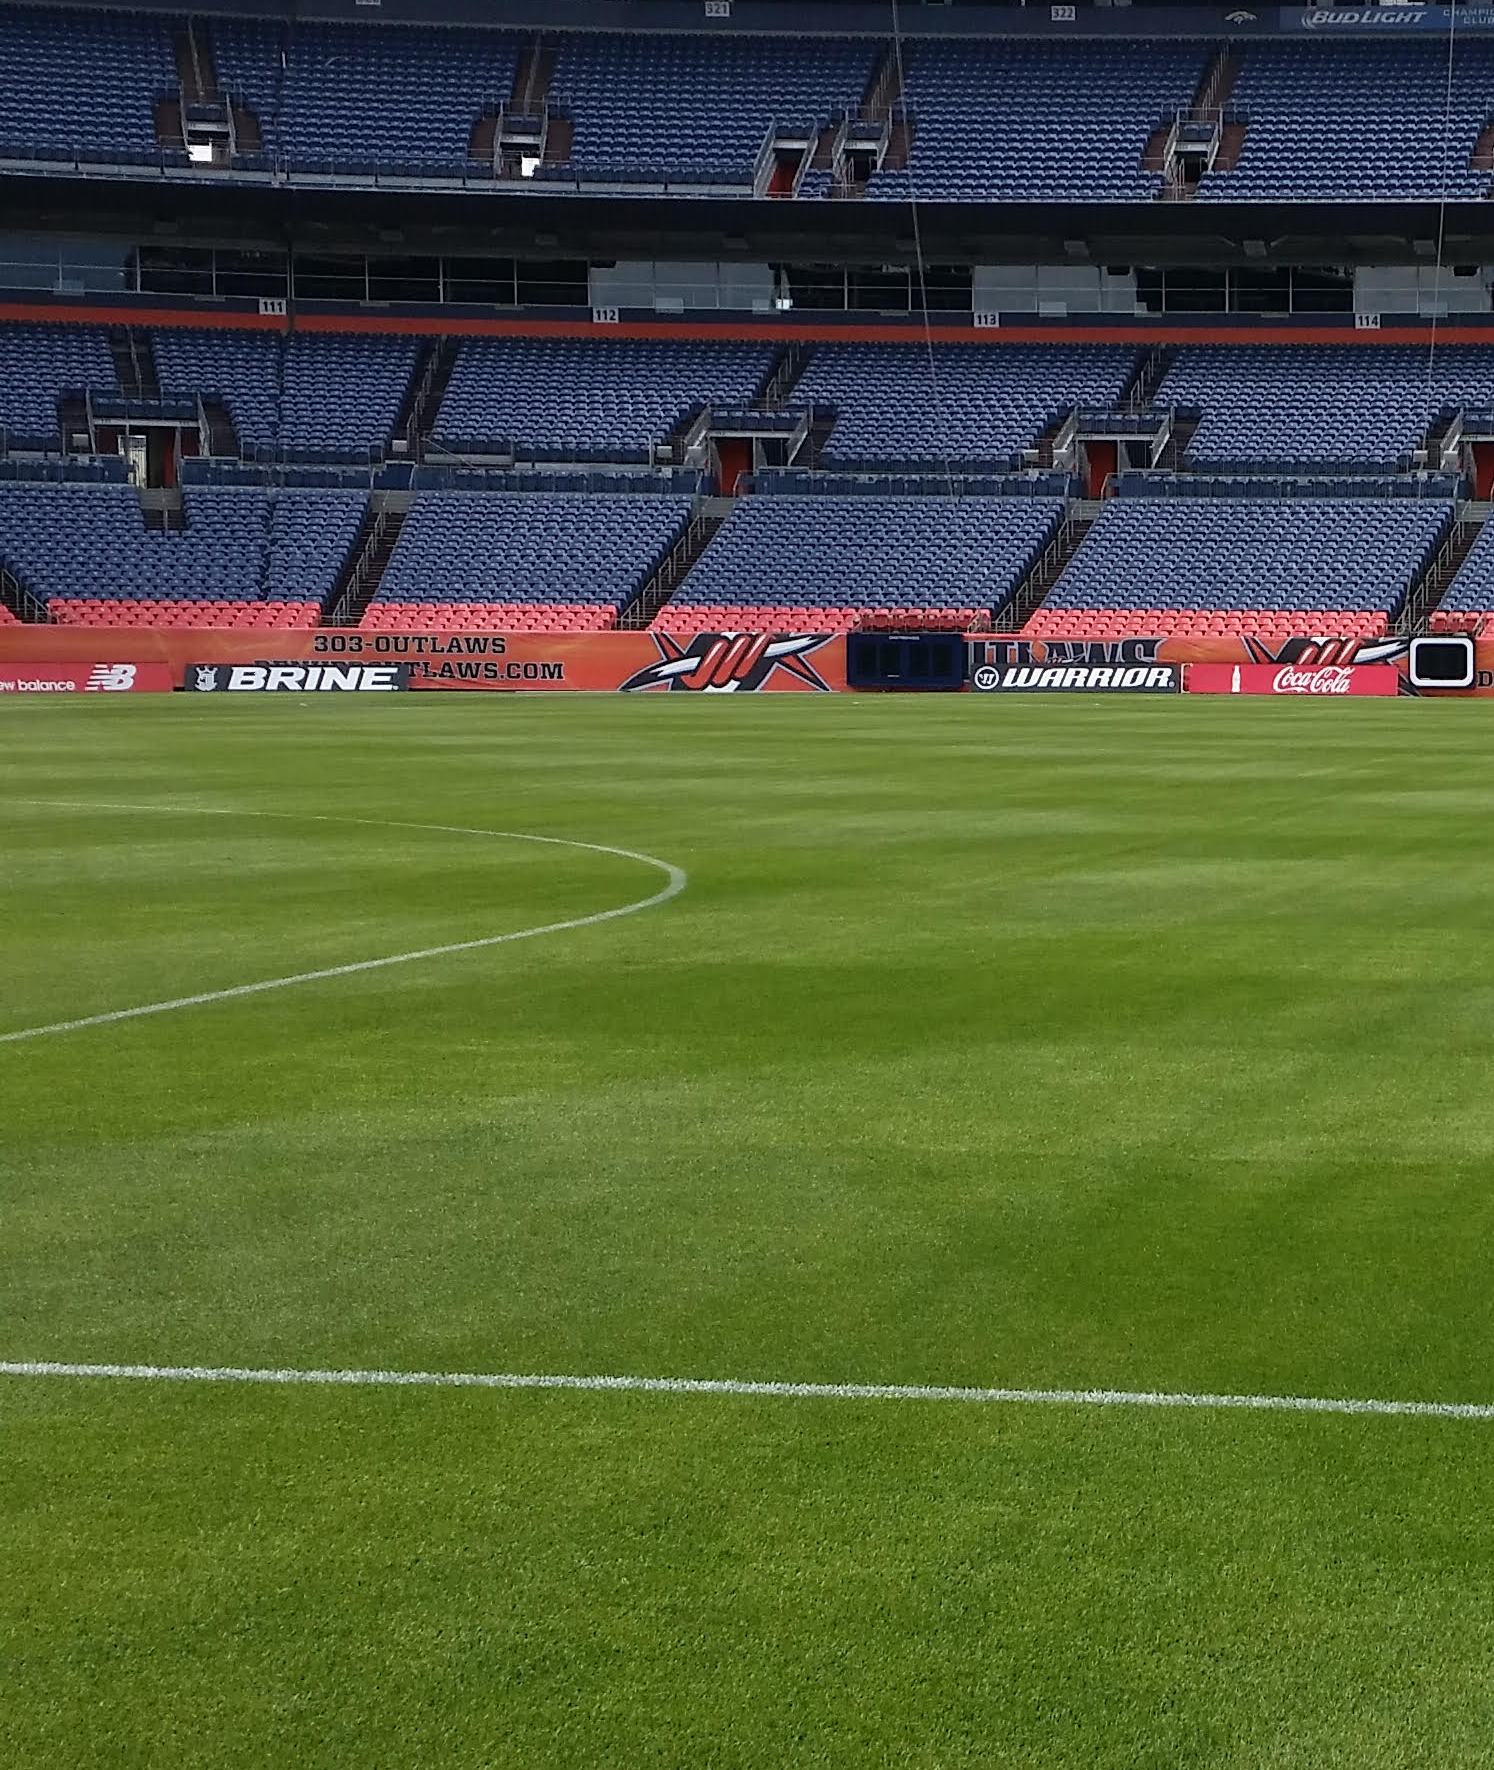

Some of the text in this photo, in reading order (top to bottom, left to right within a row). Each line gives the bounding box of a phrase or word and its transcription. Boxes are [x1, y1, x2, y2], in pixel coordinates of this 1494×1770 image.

[707, 2, 728, 14] 321
[1053, 7, 1074, 18] 322
[1312, 10, 1428, 24] BUD LIGHT
[1463, 16, 1494, 25] CLUB
[263, 301, 283, 313] 111
[596, 309, 616, 321] 112
[977, 314, 997, 326] 113
[1358, 315, 1379, 326] 114
[314, 634, 507, 654] 303-OUTLAWS
[228, 666, 399, 691] BRINE
[1002, 667, 1172, 688] WARRIOR
[1273, 666, 1355, 693] Coca-Cola
[17, 678, 76, 691] balance
